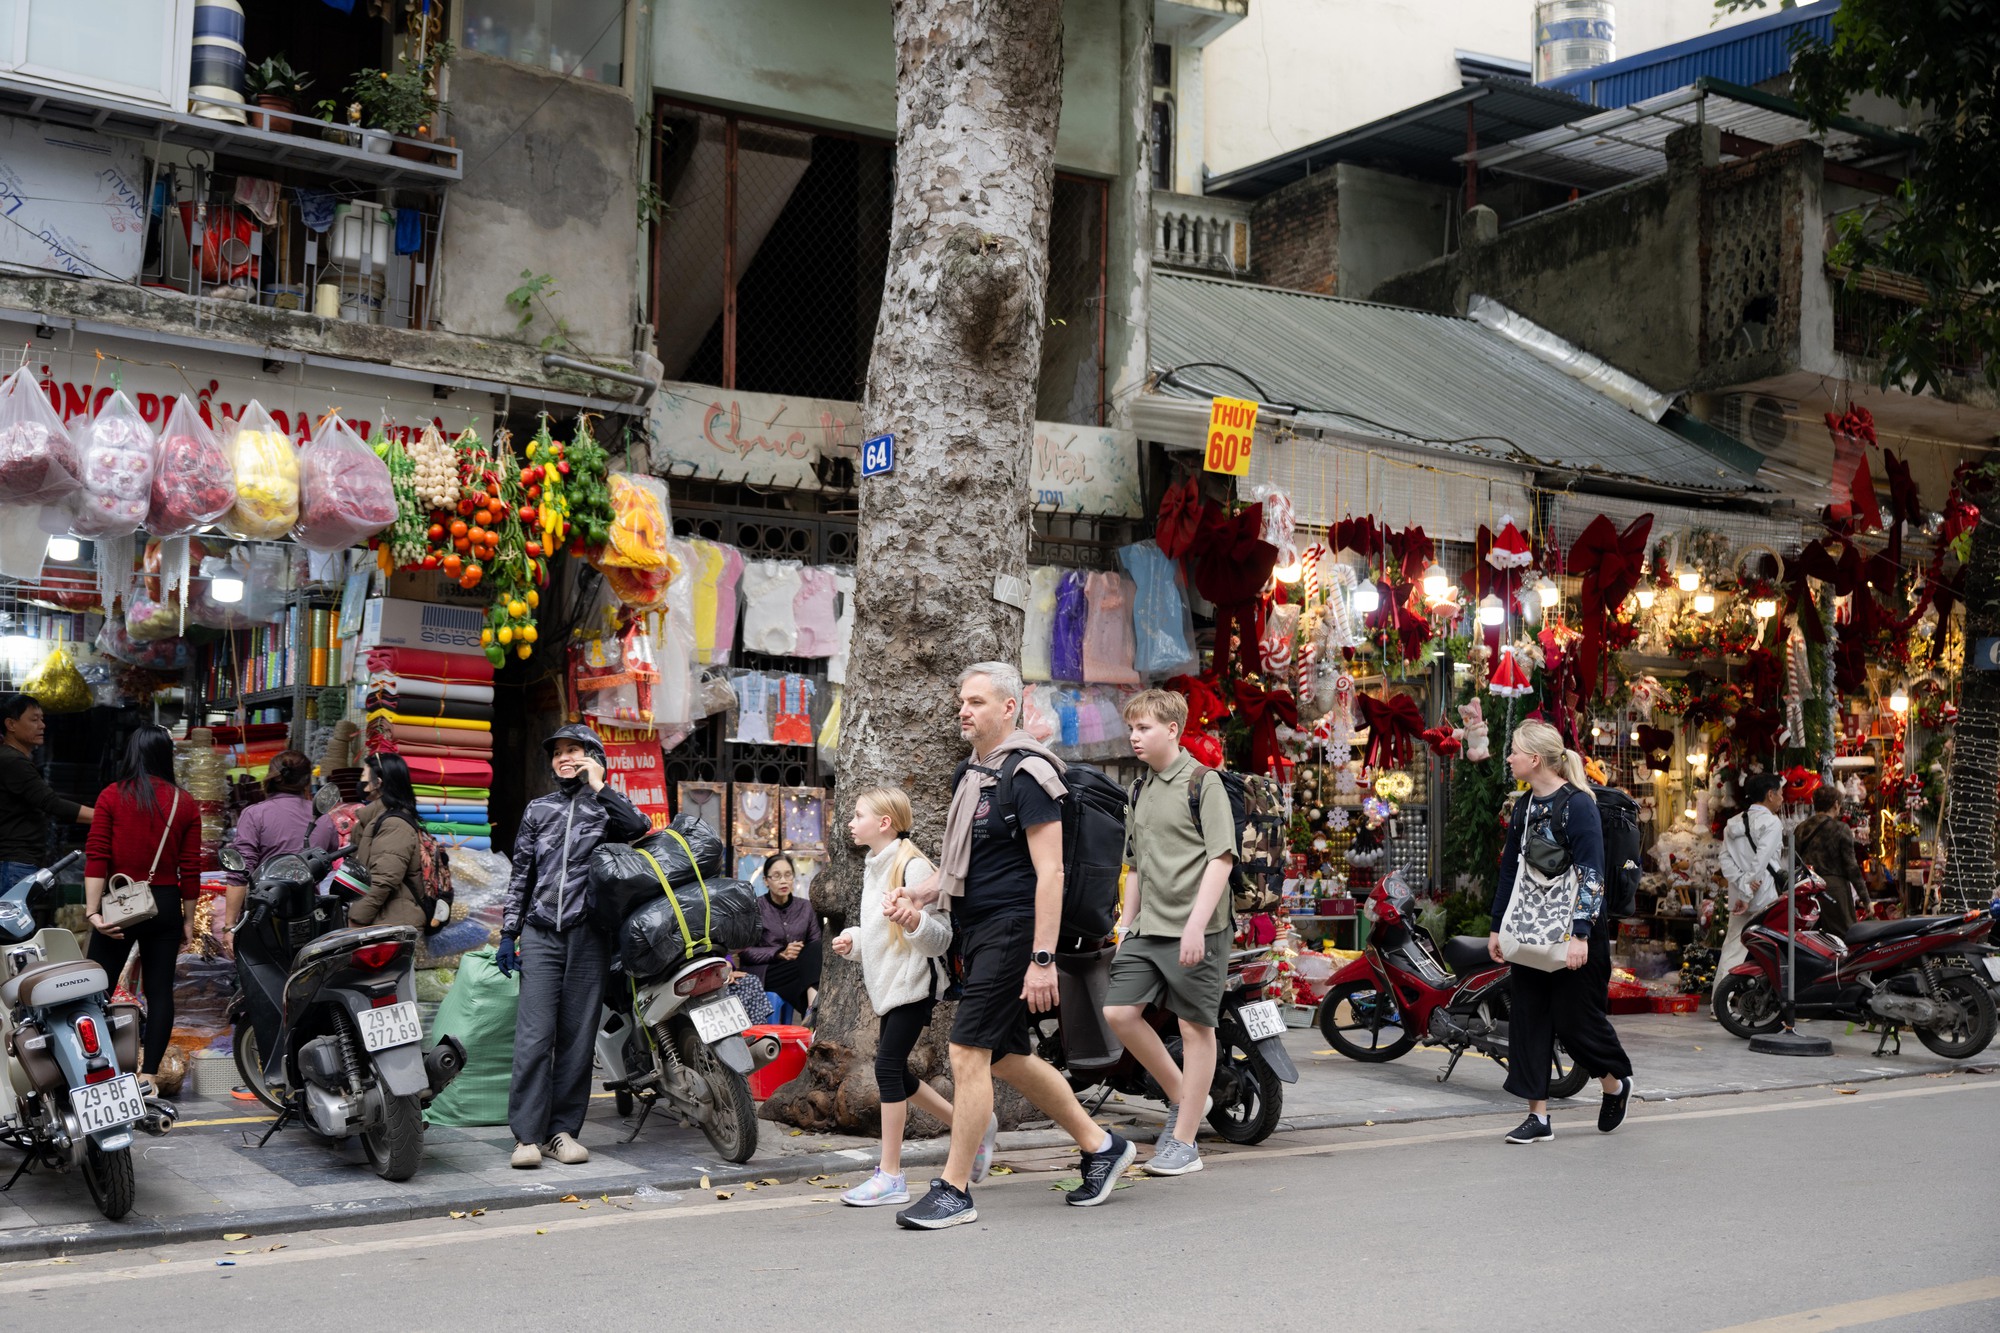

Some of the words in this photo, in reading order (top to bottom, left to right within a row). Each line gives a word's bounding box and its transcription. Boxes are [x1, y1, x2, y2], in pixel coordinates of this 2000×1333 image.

[1213, 402, 1256, 430] THÚY
[866, 441, 887, 470] 64
[636, 752, 656, 769] VÀO
[55, 977, 90, 989] HONDA
[367, 1005, 409, 1030] 29-M1
[699, 1000, 736, 1024] 29-M1
[368, 1022, 418, 1048] 372.69
[701, 1014, 747, 1041] 736.16
[81, 1079, 127, 1109] 29-BF
[82, 1098, 141, 1130] 140.98
